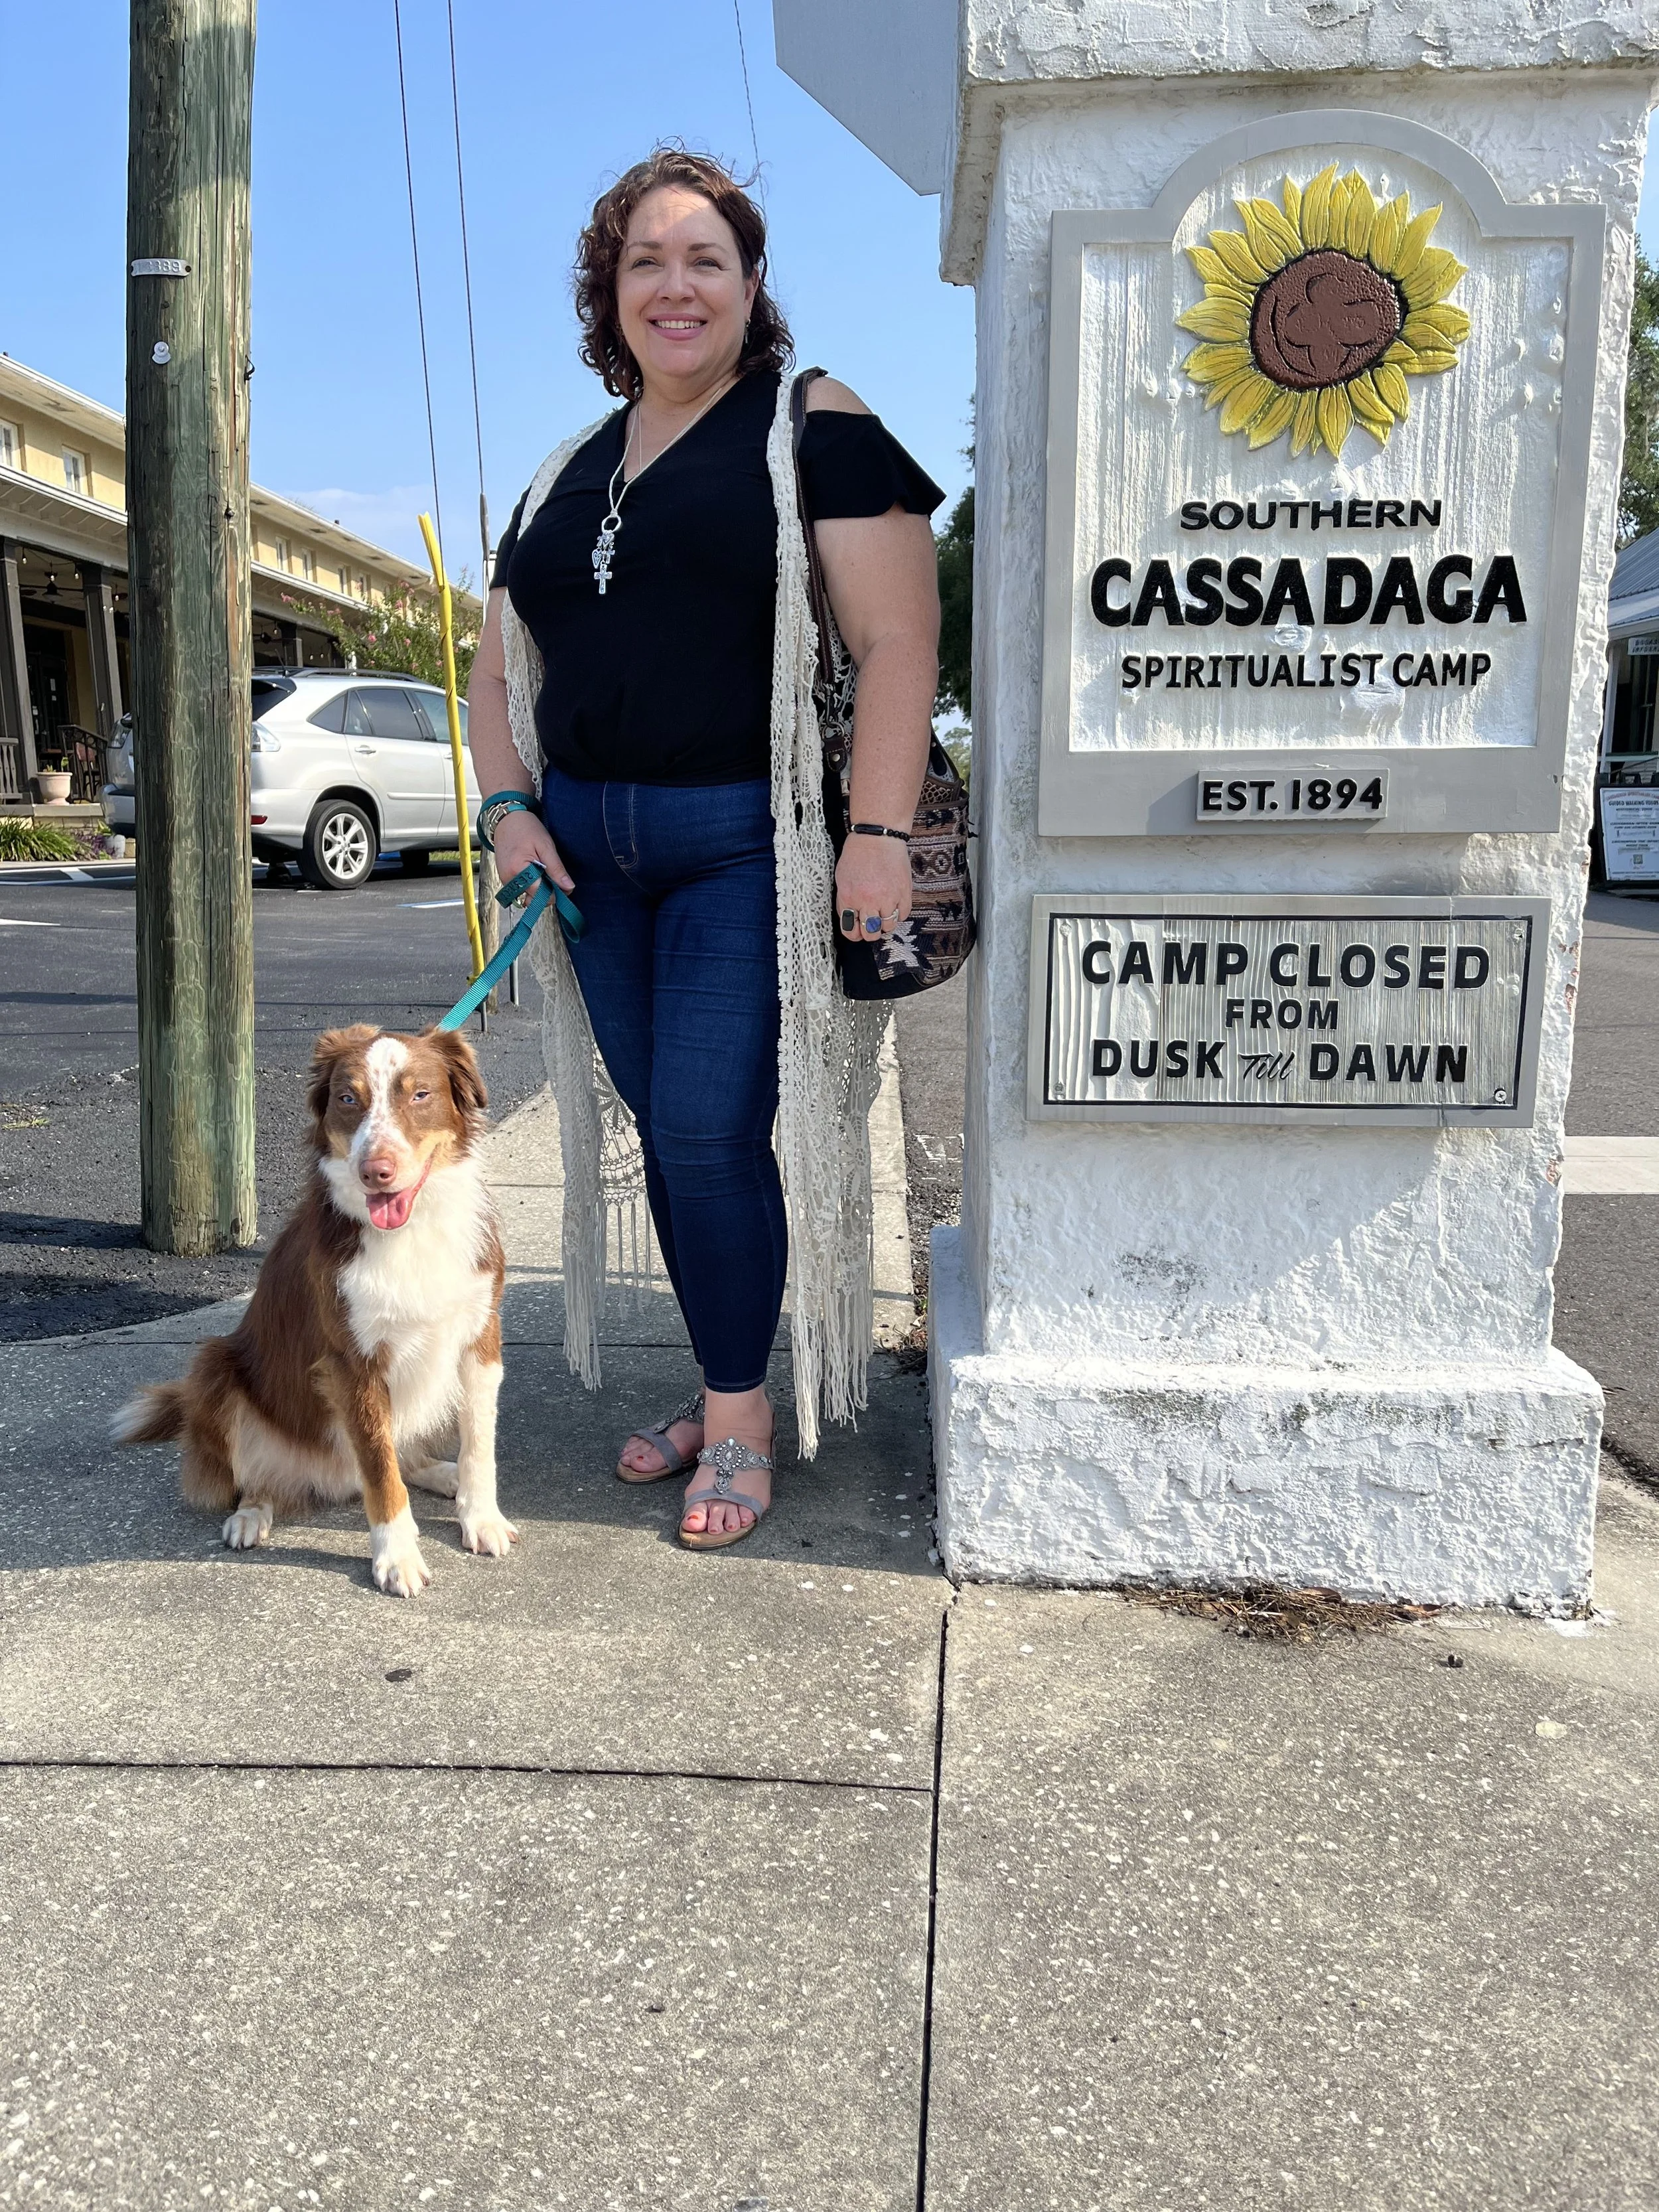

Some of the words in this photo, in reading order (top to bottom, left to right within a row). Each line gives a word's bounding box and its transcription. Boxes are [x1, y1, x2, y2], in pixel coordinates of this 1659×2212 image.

[1180, 498, 1442, 530] SOUTHERN
[1091, 555, 1527, 627] CASSADAGA
[1121, 653, 1384, 689] SPIRITUALIST
[1392, 652, 1491, 688] CAMP
[1202, 780, 1279, 811] EST.
[1291, 778, 1383, 811] 1894
[1082, 940, 1248, 986] CAMP
[1269, 942, 1490, 990] CLOSED
[1225, 998, 1339, 1030] FROM
[1092, 1039, 1226, 1078] DUSK
[1238, 1051, 1295, 1082] Till
[1309, 1044, 1469, 1082] DAWN
